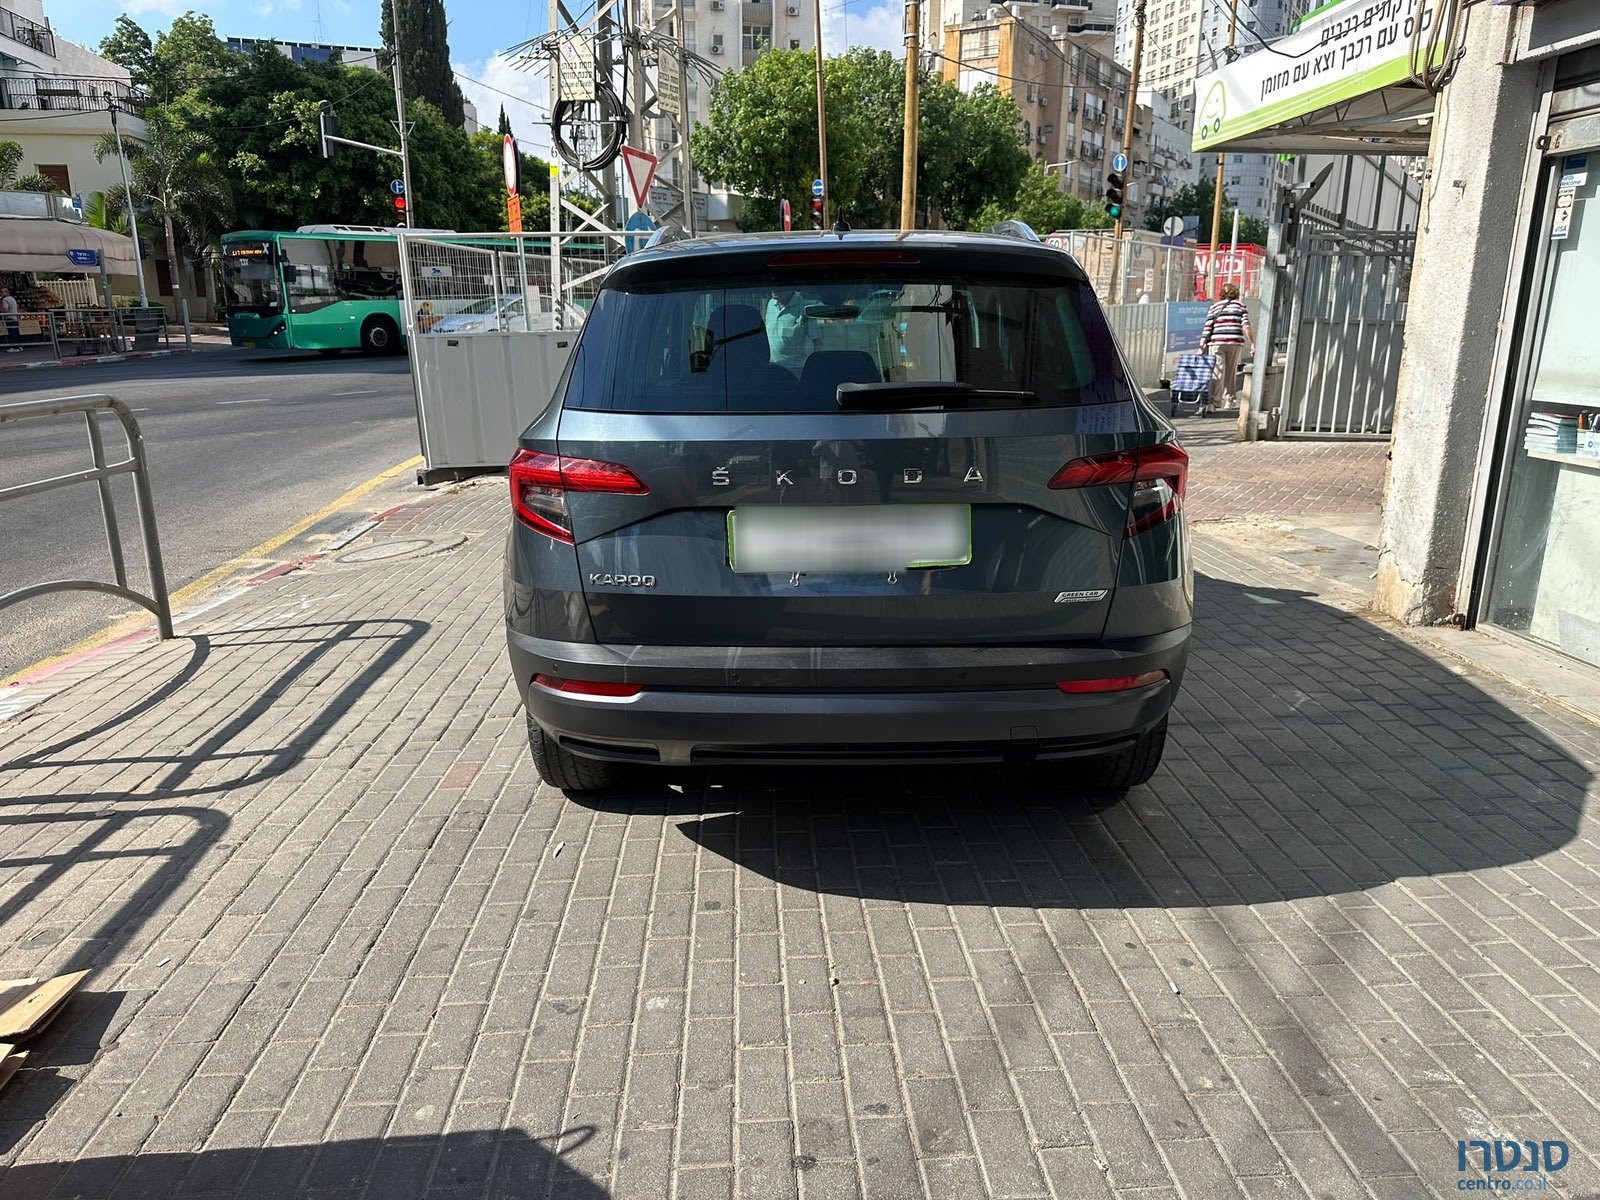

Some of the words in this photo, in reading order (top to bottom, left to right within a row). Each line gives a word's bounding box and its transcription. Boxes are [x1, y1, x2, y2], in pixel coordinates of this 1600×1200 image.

[1320, 14, 1359, 47] רכבים
[1376, 22, 1399, 49] עם
[1403, 8, 1434, 38] כס
[1313, 50, 1336, 75] וצא
[1340, 34, 1372, 70] רכבך
[1260, 69, 1290, 101] מזומן
[1292, 60, 1310, 83] עם
[711, 466, 984, 486] ŠKODA
[589, 573, 656, 587] KAROQ
